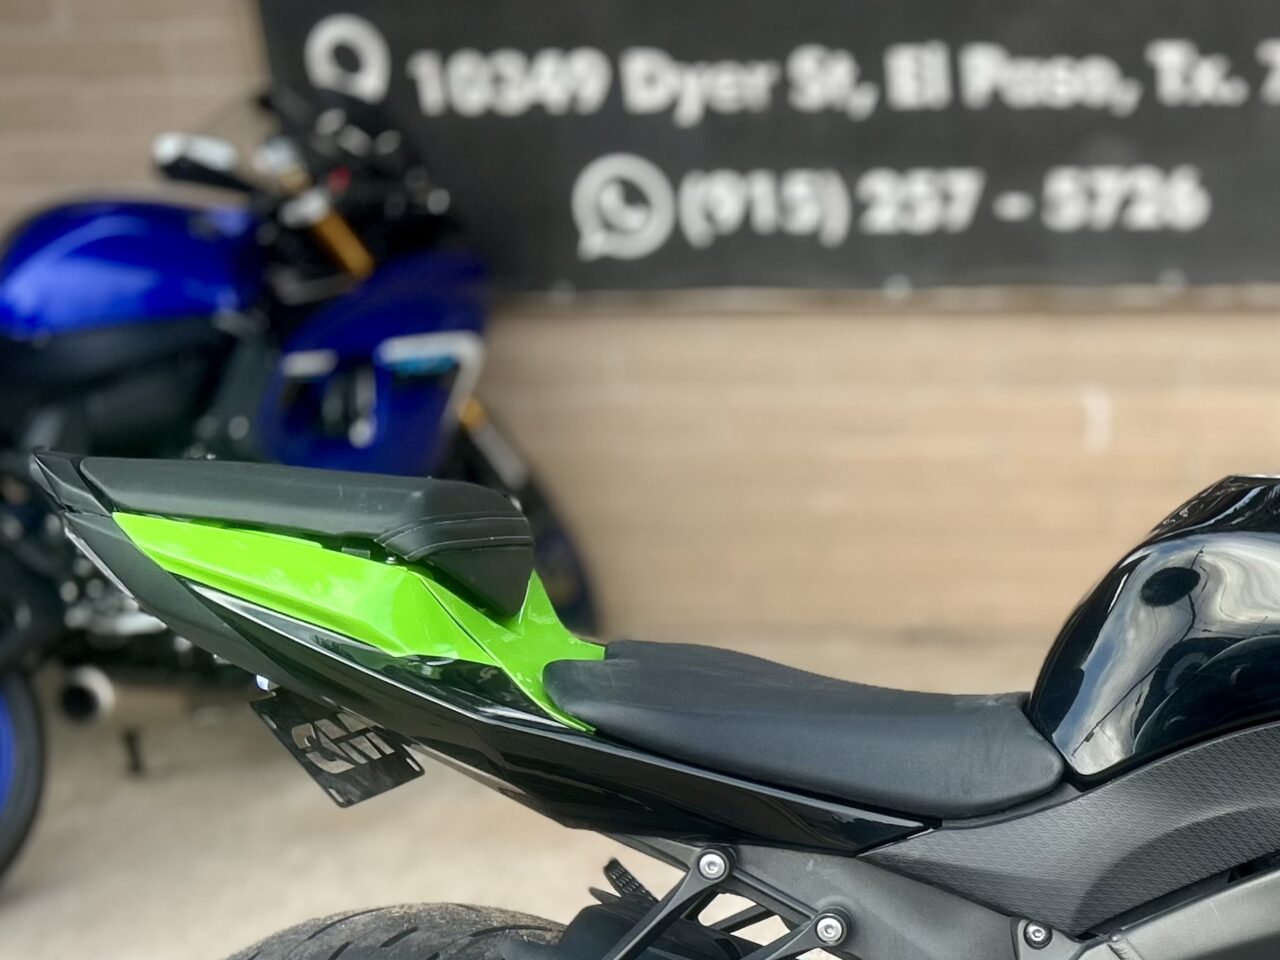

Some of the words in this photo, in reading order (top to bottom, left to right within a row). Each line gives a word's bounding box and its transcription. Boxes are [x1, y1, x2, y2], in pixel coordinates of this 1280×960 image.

[412, 47, 610, 114] 10349
[620, 48, 777, 126] Dyer
[788, 46, 877, 118] St,
[885, 42, 951, 109] El
[960, 42, 1140, 113] Paso,
[1147, 39, 1247, 104] Tx.
[677, 169, 850, 246] (915)
[856, 168, 983, 234] 257
[1043, 165, 1211, 230] 5726
